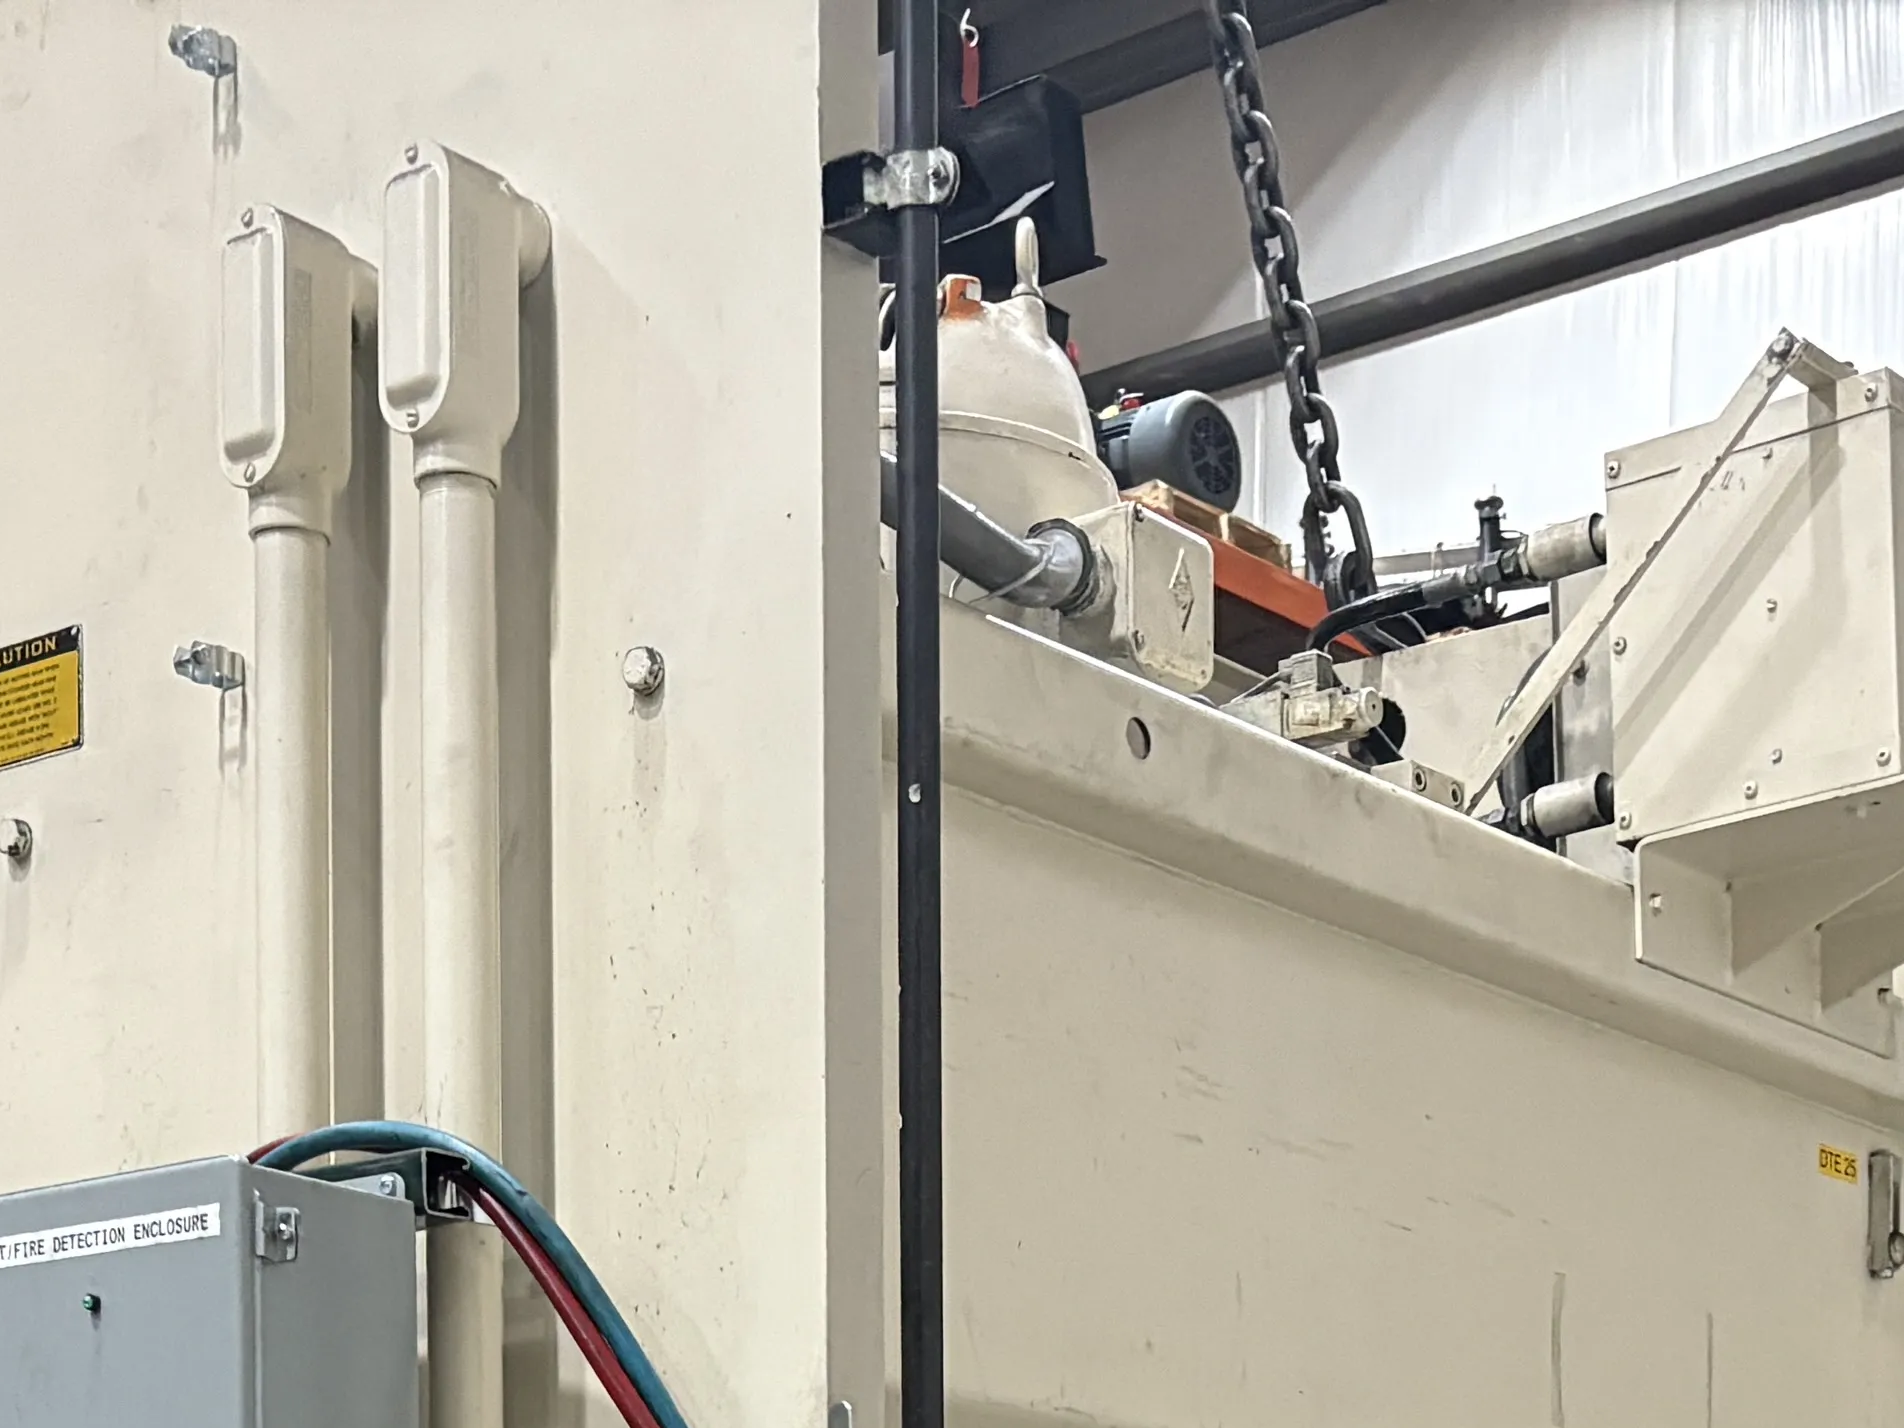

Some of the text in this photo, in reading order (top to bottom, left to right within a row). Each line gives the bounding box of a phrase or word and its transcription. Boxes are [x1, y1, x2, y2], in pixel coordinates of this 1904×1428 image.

[1819, 1148, 1843, 1174] DTE
[52, 1226, 125, 1254] DETECTION
[133, 1212, 209, 1241] ENCLOSURE
